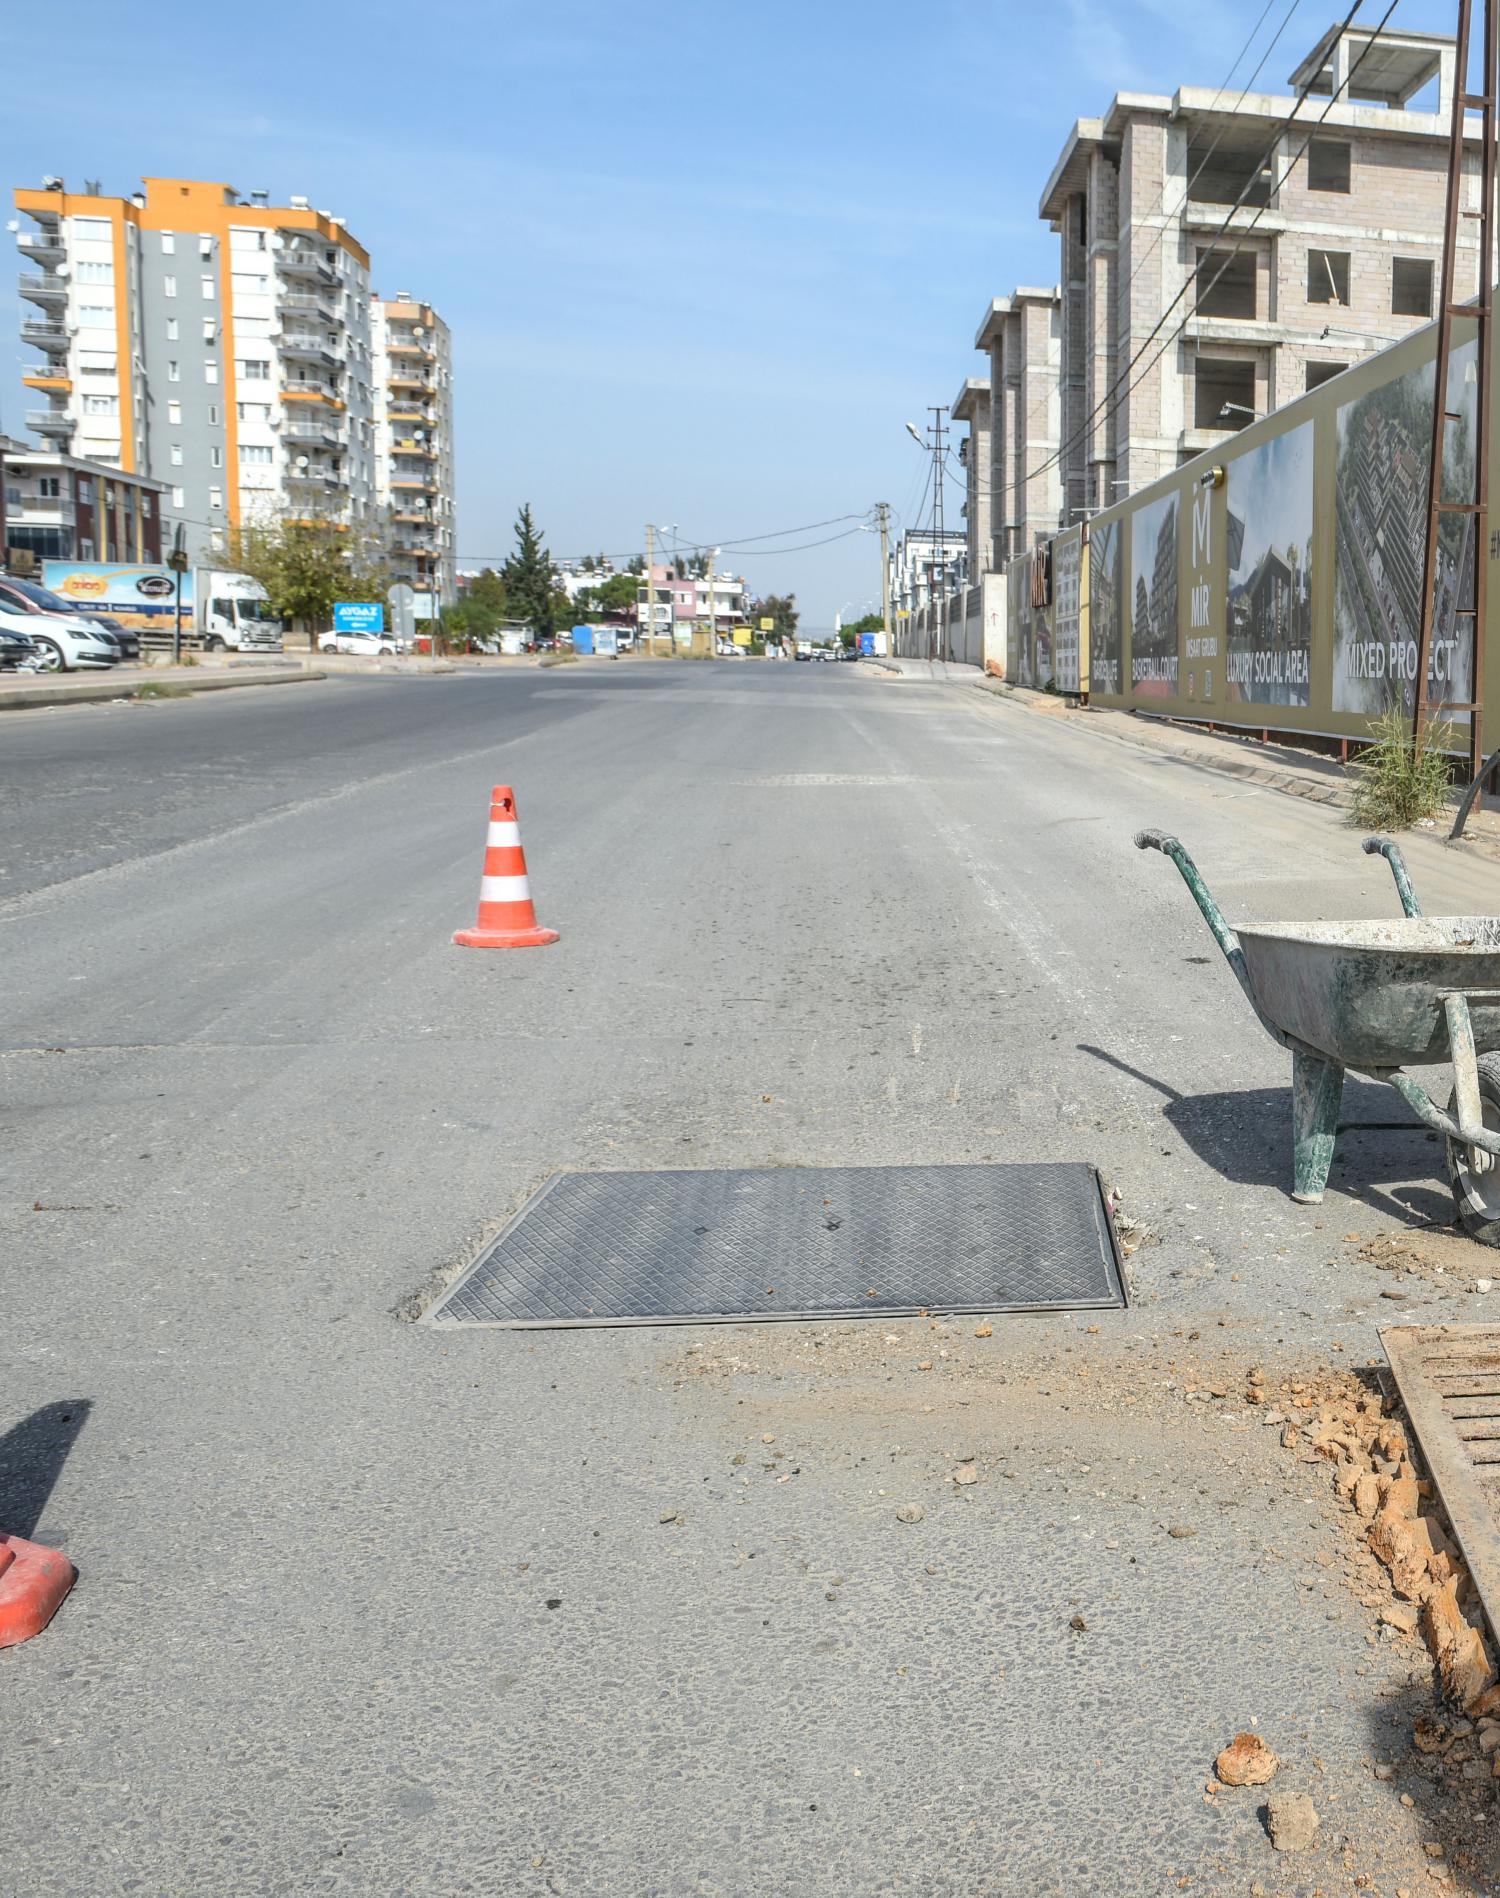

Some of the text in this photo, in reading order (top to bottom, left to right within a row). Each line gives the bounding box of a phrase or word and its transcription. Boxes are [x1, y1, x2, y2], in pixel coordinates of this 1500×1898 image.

[339, 606, 378, 616] AYGAZ
[1191, 575, 1210, 627] MİR
[1227, 649, 1309, 683] LUXURY SOCIAL AREA
[1346, 639, 1455, 682] MIXED PROECT
